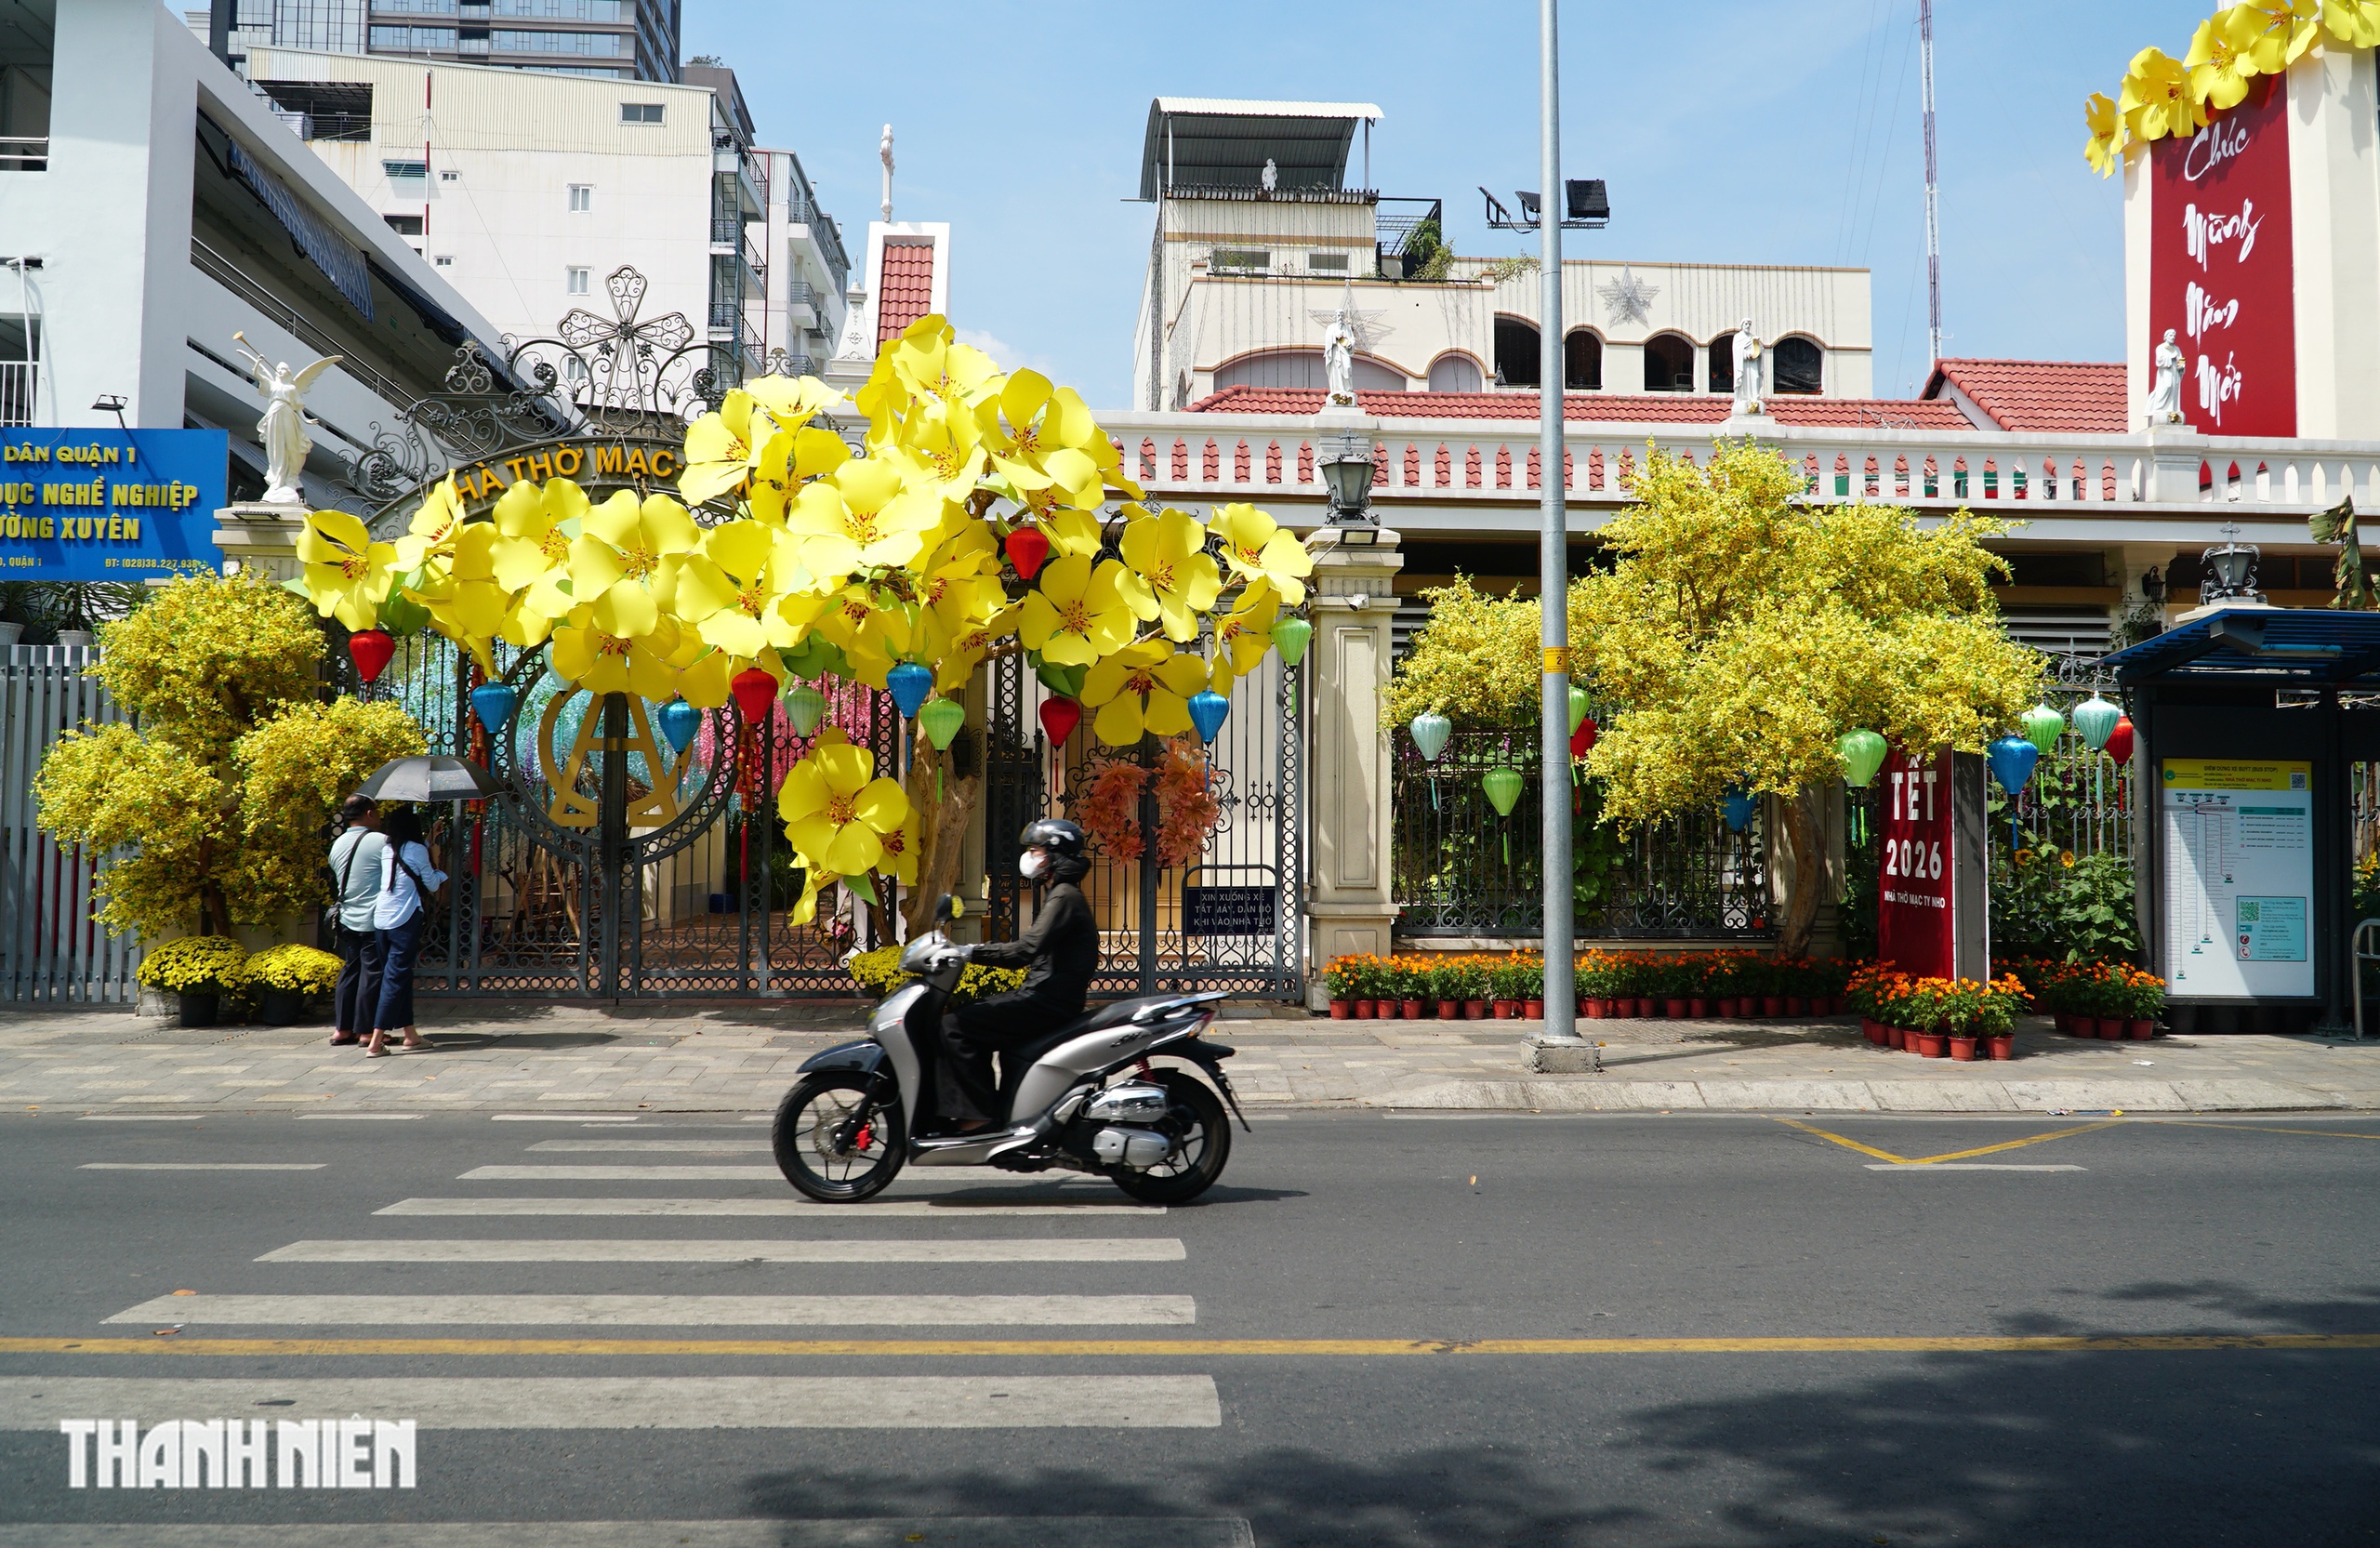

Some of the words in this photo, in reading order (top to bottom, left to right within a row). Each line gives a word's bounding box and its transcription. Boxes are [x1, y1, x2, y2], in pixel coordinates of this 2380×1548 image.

[2184, 117, 2251, 181] Chúc
[2182, 197, 2266, 273] Mừng
[2186, 281, 2239, 351] Năm
[2195, 351, 2241, 428] Mới
[4, 442, 50, 462] DÂN
[56, 443, 119, 468] QUẬN
[126, 447, 136, 463] 1
[428, 461, 506, 505] HÀ
[504, 443, 584, 482] THỜ
[596, 446, 684, 480] MẠC-
[0, 482, 34, 509] ỤC
[43, 475, 104, 506] NGHỀ
[112, 480, 198, 511] NGHIỆP
[60, 513, 139, 540] XUYÊN
[9, 555, 34, 568] QUẬN
[37, 558, 42, 567] 1
[1556, 655, 1562, 665] 2
[1891, 751, 1937, 821] TẾT
[1886, 839, 1942, 880] 2026
[1884, 889, 1897, 902] NHÀ
[1909, 893, 1923, 908] MẠC
[1924, 895, 1931, 906] TY
[1931, 896, 1946, 908] NHO
